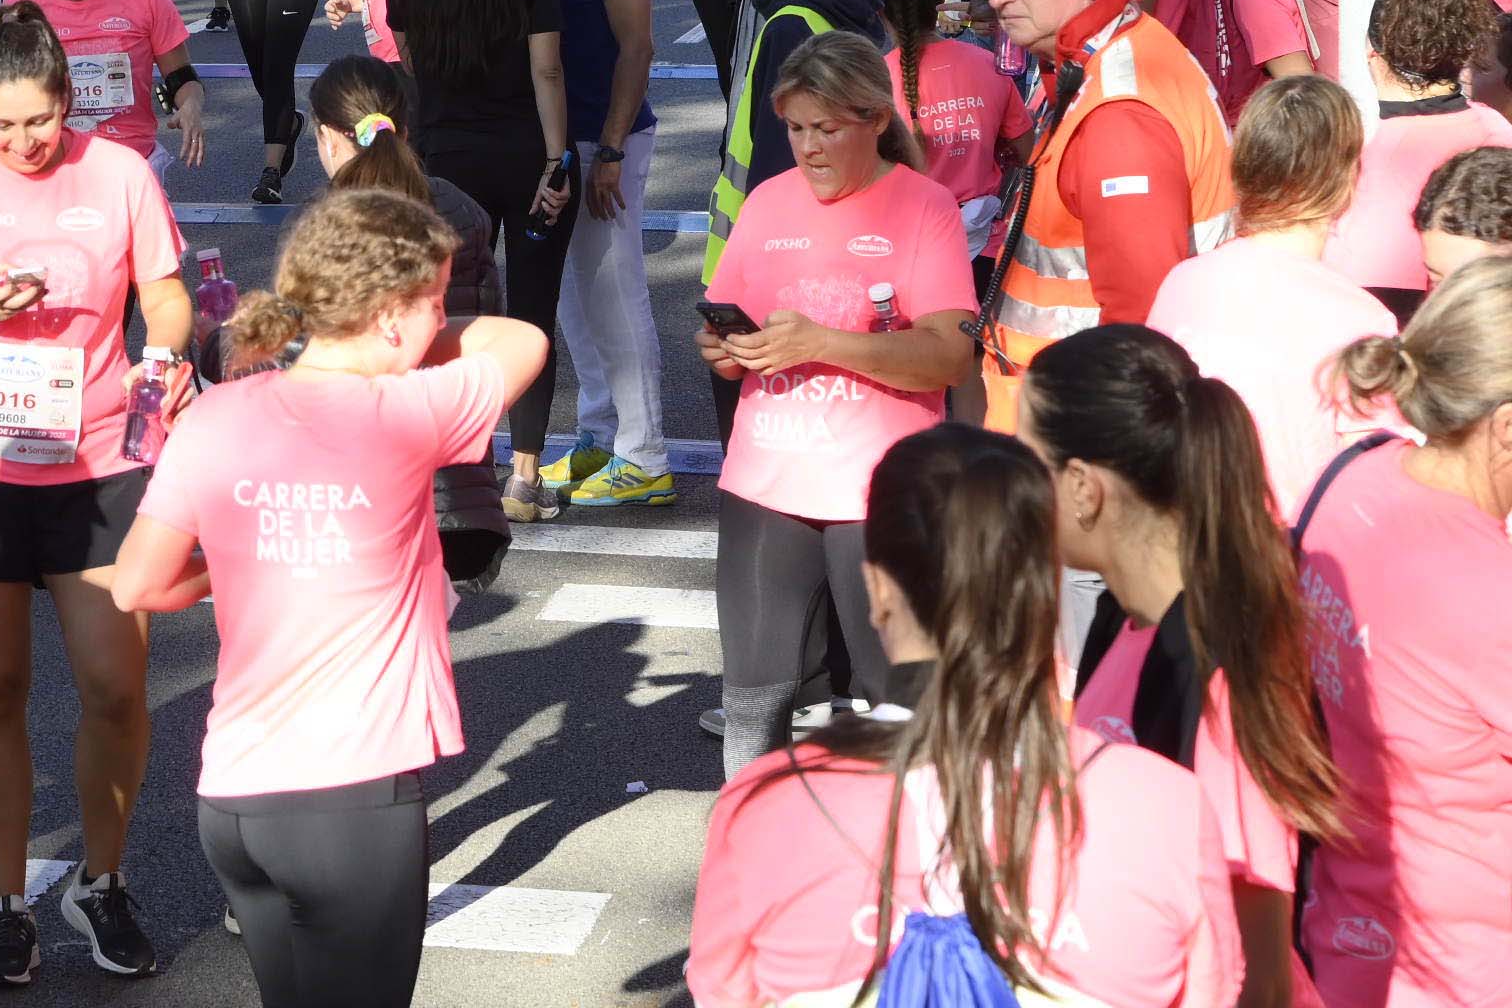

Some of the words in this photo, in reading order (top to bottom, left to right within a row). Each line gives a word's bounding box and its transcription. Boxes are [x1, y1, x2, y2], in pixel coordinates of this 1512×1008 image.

[919, 96, 984, 118] CARRERA
[934, 117, 953, 131] DE
[958, 113, 975, 126] LA
[934, 128, 981, 147] MUJER
[0, 412, 26, 424] 9608
[232, 479, 373, 511] CARRERA
[258, 508, 294, 536] DE
